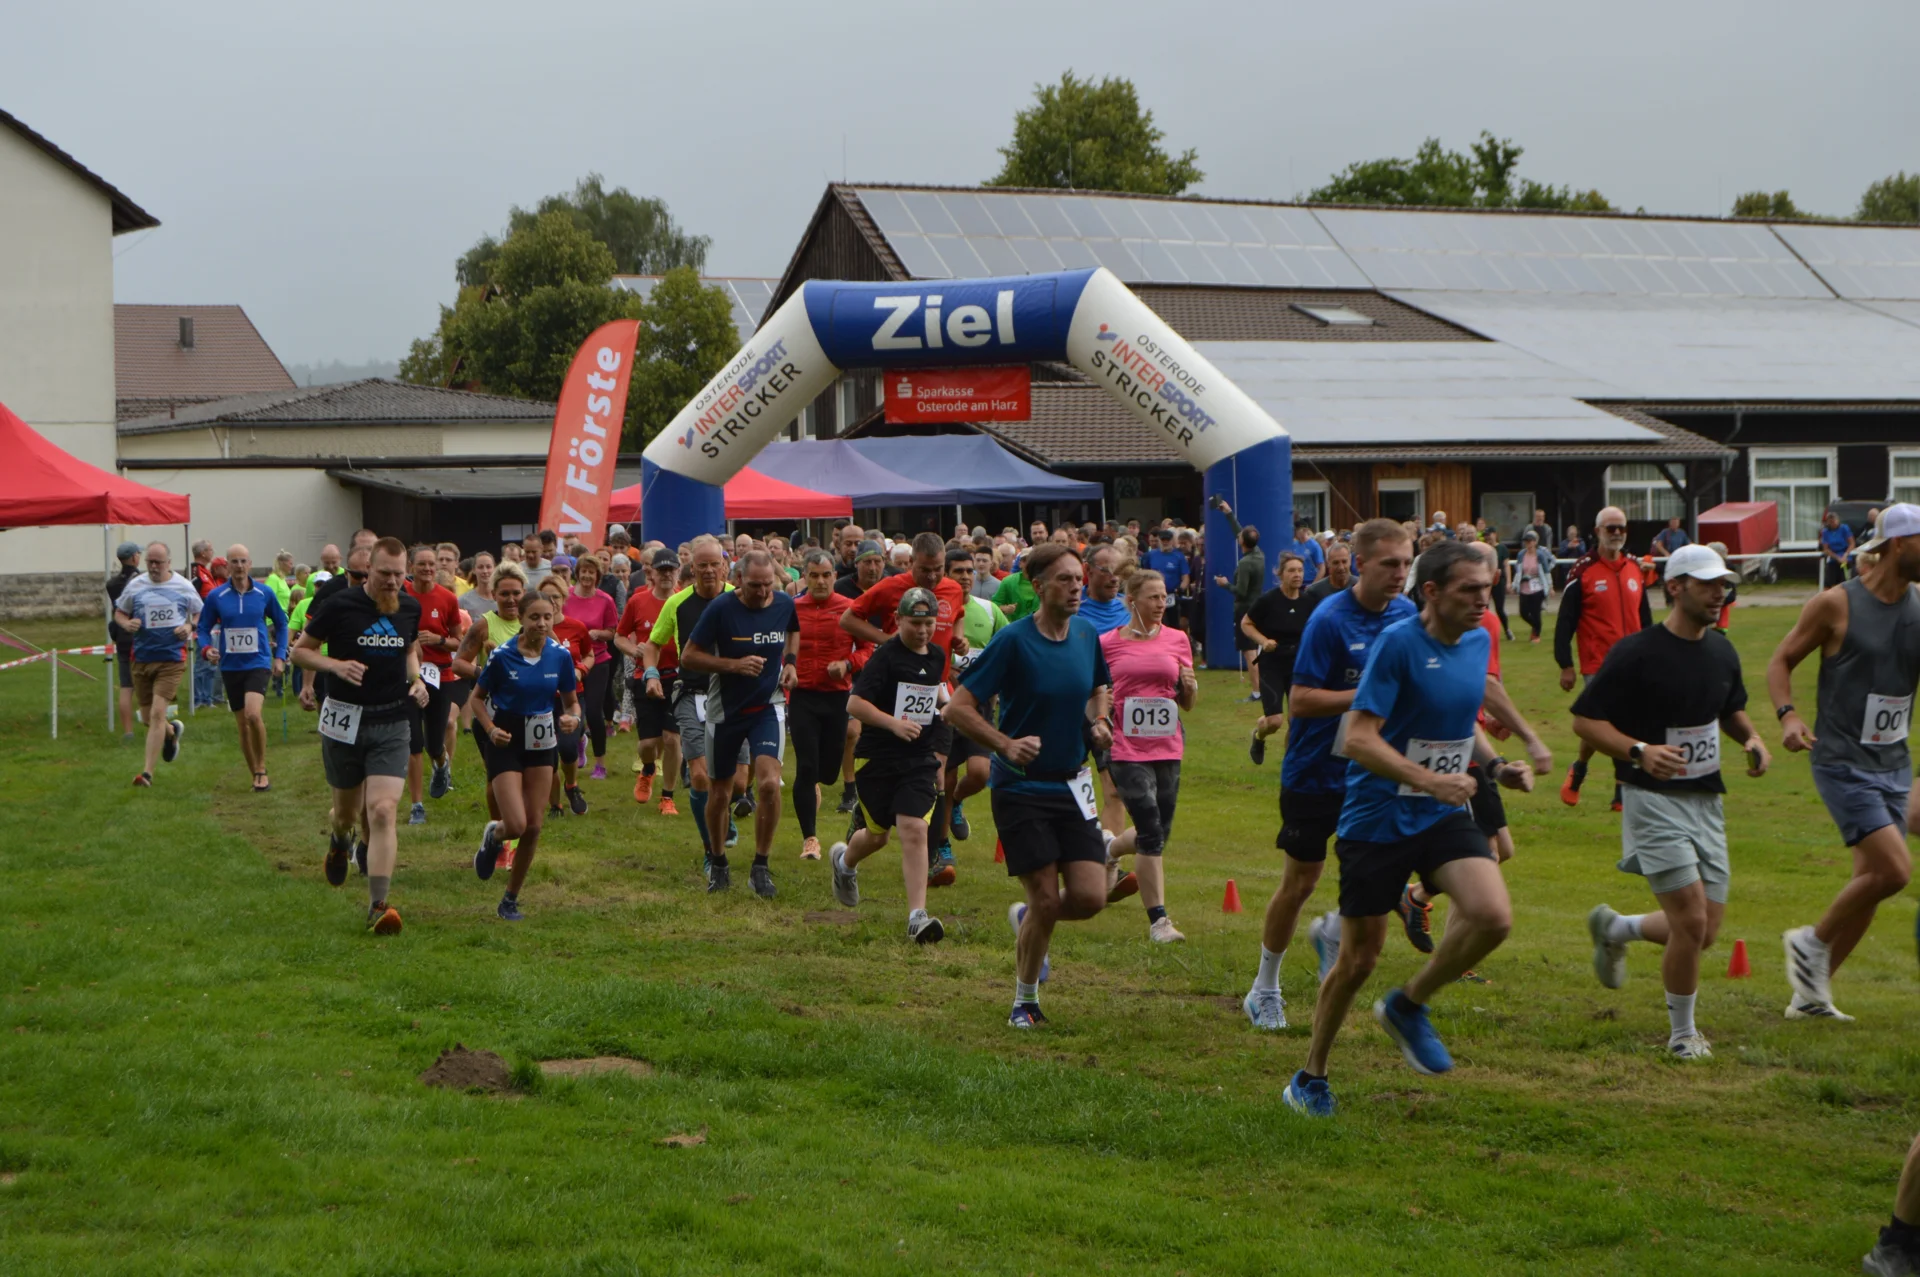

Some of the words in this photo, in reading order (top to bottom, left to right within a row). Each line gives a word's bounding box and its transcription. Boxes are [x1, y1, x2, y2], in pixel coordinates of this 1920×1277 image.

[871, 289, 1016, 350] Ziel
[695, 348, 755, 411] OSTERODE
[1112, 338, 1217, 433] INTERSPORT
[1137, 334, 1206, 396] OSTERODE
[694, 339, 788, 435] INTERSPORT
[917, 387, 974, 399] Sparkasse
[917, 401, 968, 413] Osterode
[970, 402, 989, 411] am
[991, 400, 1018, 411] Harz
[1091, 349, 1194, 448] STRICKER
[566, 346, 621, 495] Förste
[701, 362, 802, 459] STRICKER
[150, 609, 175, 621] 262
[230, 634, 253, 646] 170
[357, 634, 405, 647] adidas
[321, 707, 352, 731] 214
[903, 695, 934, 714] 252
[1131, 707, 1170, 726] 013
